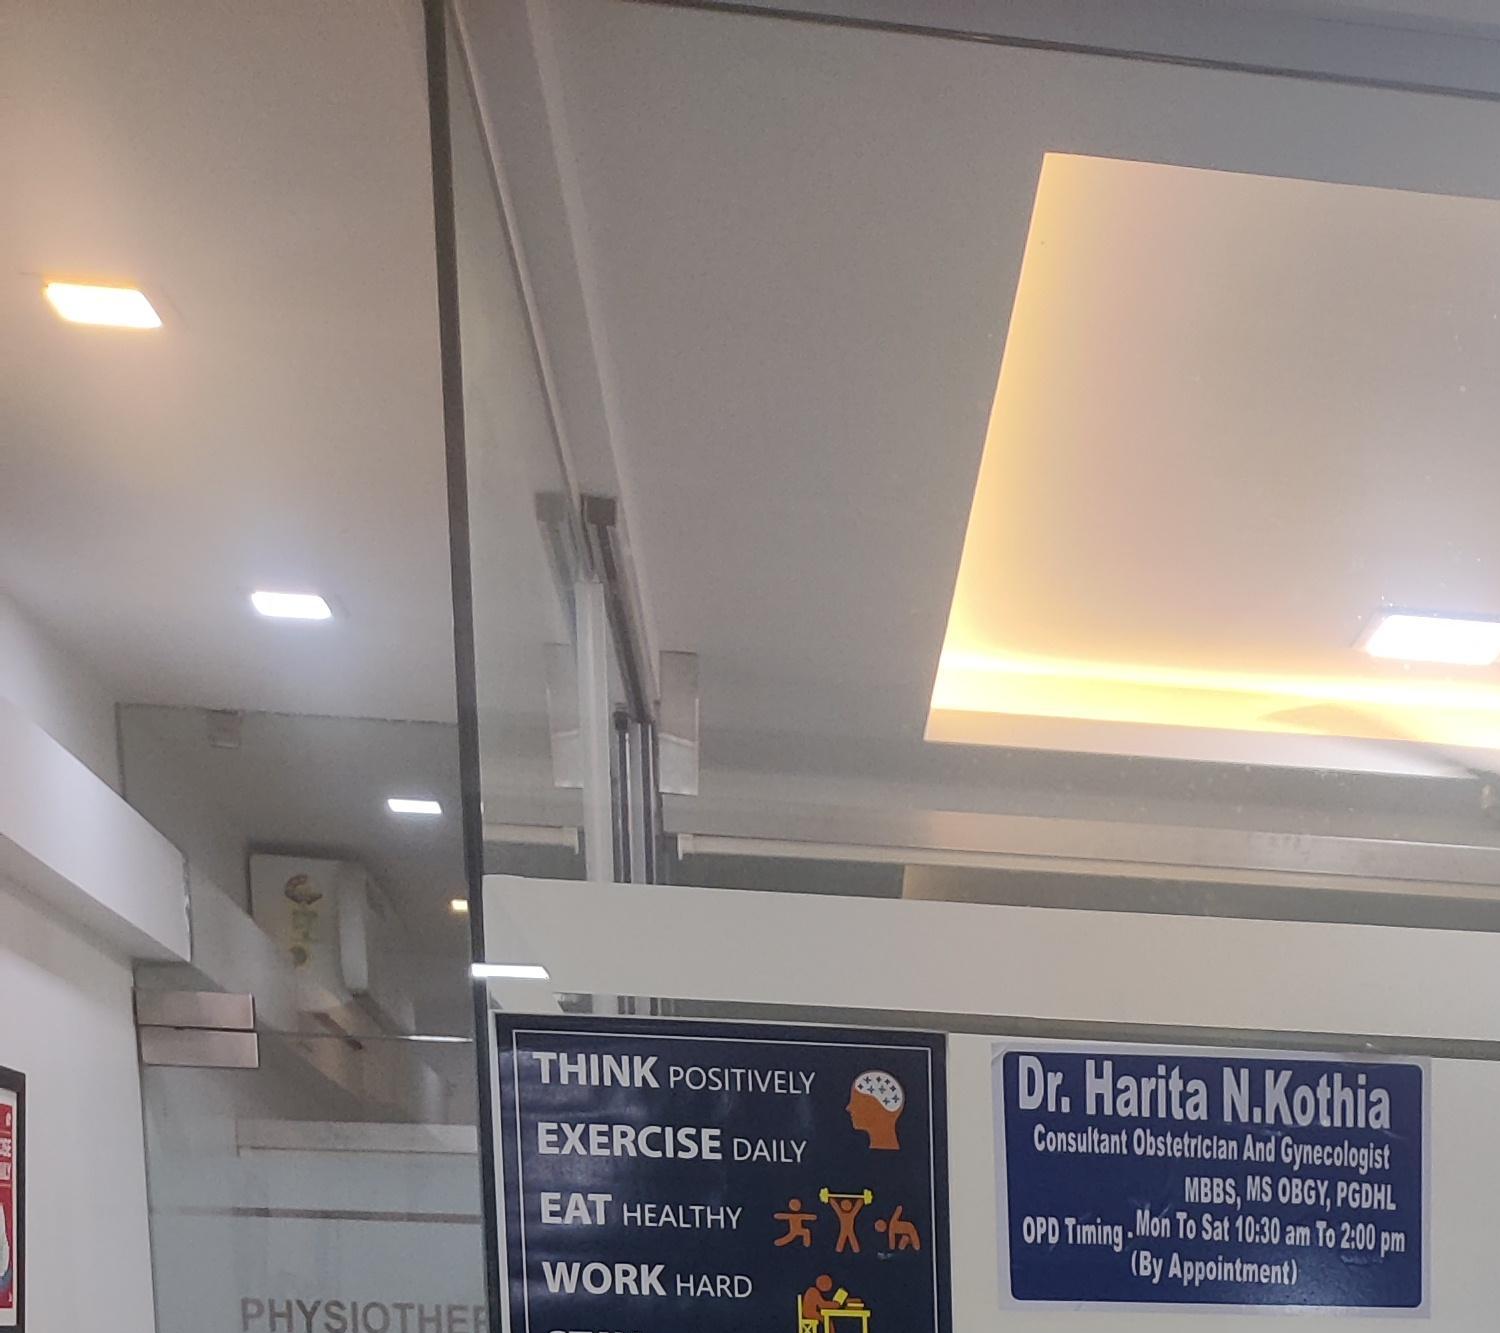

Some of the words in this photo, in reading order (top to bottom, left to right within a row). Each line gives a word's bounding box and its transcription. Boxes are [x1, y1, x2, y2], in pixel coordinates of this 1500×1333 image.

[533, 1052, 660, 1089] THINK
[669, 1066, 815, 1095] POSITIVELY
[1018, 1055, 1070, 1113] Dr.
[1085, 1059, 1208, 1121] Harita
[1223, 1065, 1391, 1129] N.Kothia
[537, 1122, 722, 1161] EXERCISE
[732, 1136, 807, 1164] DAILY
[1033, 1124, 1128, 1155] Consultant
[1243, 1134, 1275, 1163] And
[1281, 1136, 1390, 1175] Gynecologist
[541, 1193, 612, 1226] EAT
[623, 1203, 742, 1230] HEALTHY
[1185, 1177, 1241, 1211] MBBS,
[1246, 1175, 1272, 1203] MS
[1278, 1177, 1331, 1212] OBGY,
[1337, 1181, 1397, 1211] PGDHL
[1022, 1215, 1060, 1244] OPD
[1064, 1217, 1123, 1253] Timing
[1136, 1208, 1170, 1238] Mon
[1176, 1211, 1196, 1240] To
[1201, 1212, 1230, 1242] Sat
[1235, 1214, 1280, 1244] 10:30
[1285, 1223, 1311, 1247] am
[1315, 1220, 1336, 1248] To
[1340, 1221, 1376, 1250] 2:00
[1380, 1230, 1406, 1258] pm
[542, 1261, 666, 1297] WORK
[676, 1272, 752, 1299] HARD
[1131, 1249, 1163, 1285] (By
[1168, 1251, 1298, 1287] Appointment)
